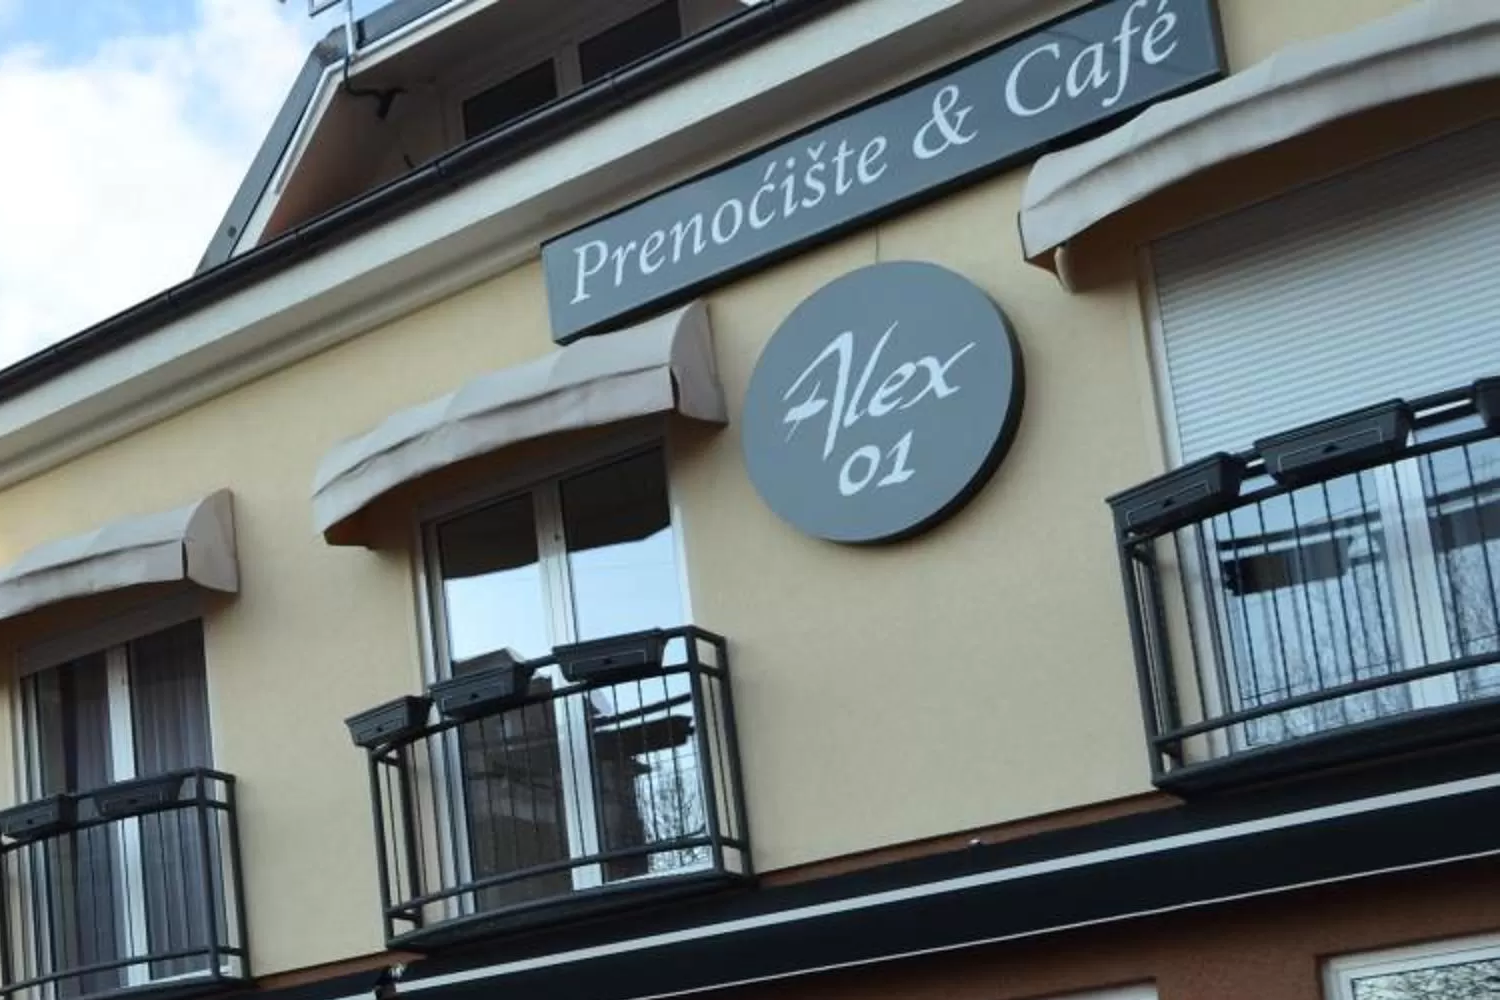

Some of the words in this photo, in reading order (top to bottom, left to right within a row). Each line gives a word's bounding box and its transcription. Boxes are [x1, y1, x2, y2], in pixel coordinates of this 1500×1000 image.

[569, 136, 888, 304] Prenoćište
[912, 85, 978, 160] &
[1004, 0, 1179, 118] Café
[782, 320, 976, 461] Alex
[837, 431, 916, 497] 01
